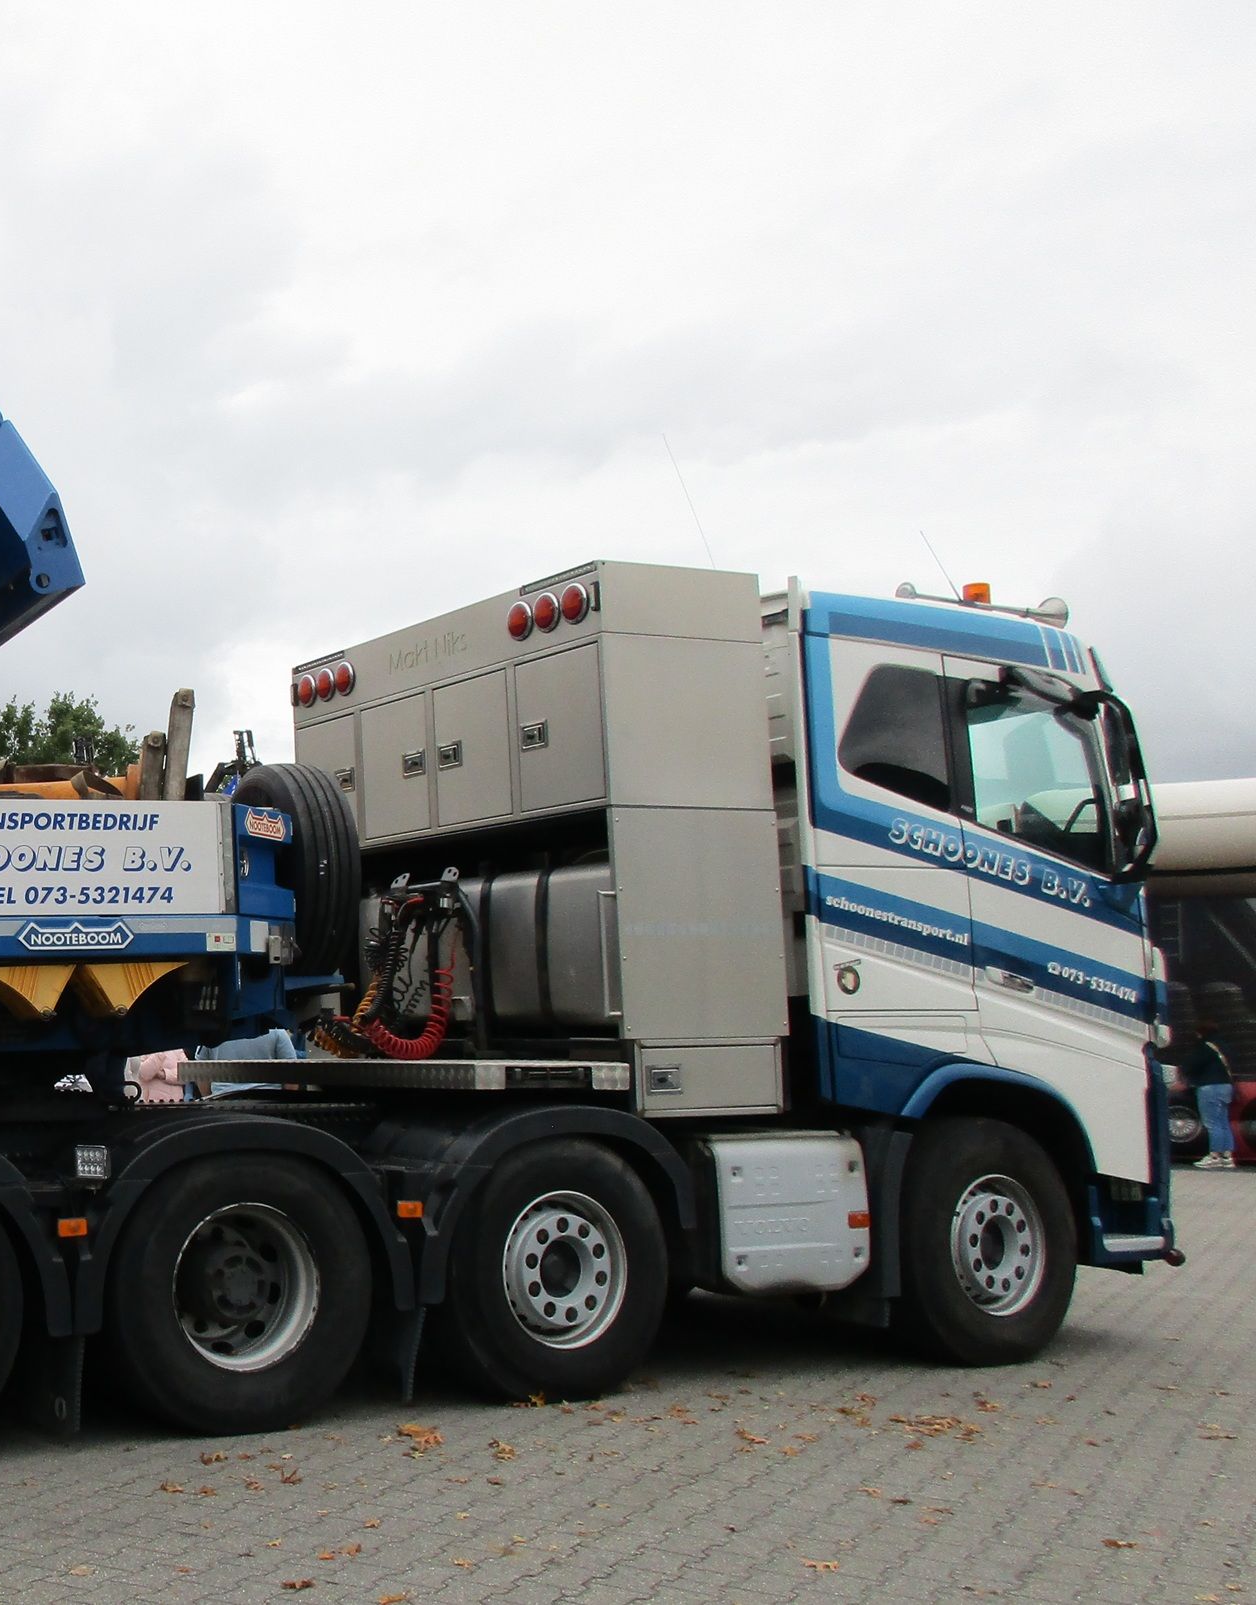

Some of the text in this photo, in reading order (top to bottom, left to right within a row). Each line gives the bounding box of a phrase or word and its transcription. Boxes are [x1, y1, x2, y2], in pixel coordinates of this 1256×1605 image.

[249, 820, 282, 836] NOOTEBOOM
[122, 846, 192, 873] B.V.
[888, 817, 1091, 908] SCHOONES B.V.
[24, 885, 175, 905] 073-5321474
[825, 895, 969, 946] schoonestransport.nl
[30, 932, 123, 945] NOOTEBOOM
[1061, 966, 1140, 1004] 073-5321474
